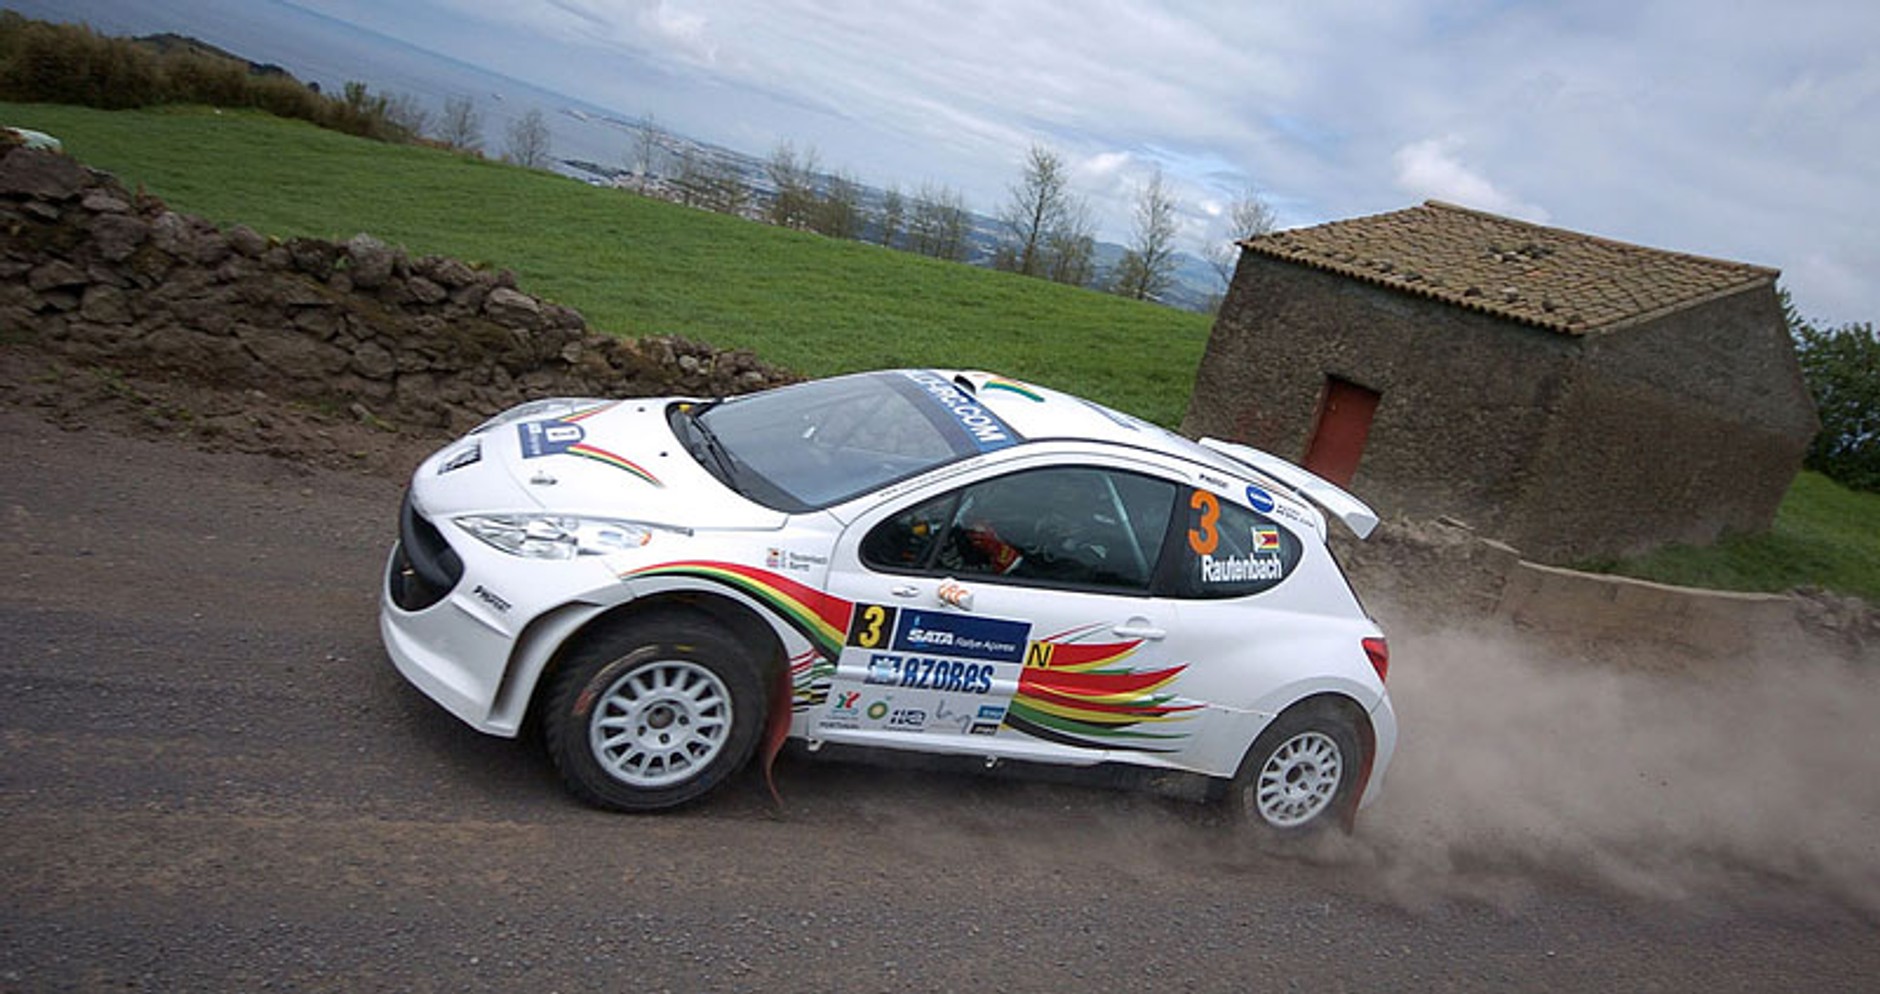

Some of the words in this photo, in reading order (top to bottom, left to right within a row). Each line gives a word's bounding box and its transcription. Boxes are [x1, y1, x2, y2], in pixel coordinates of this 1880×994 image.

[1187, 488, 1221, 555] 3
[1202, 553, 1282, 582] Rautenbach
[859, 605, 885, 648] 3
[907, 629, 954, 646] SATA
[1026, 643, 1052, 668] N
